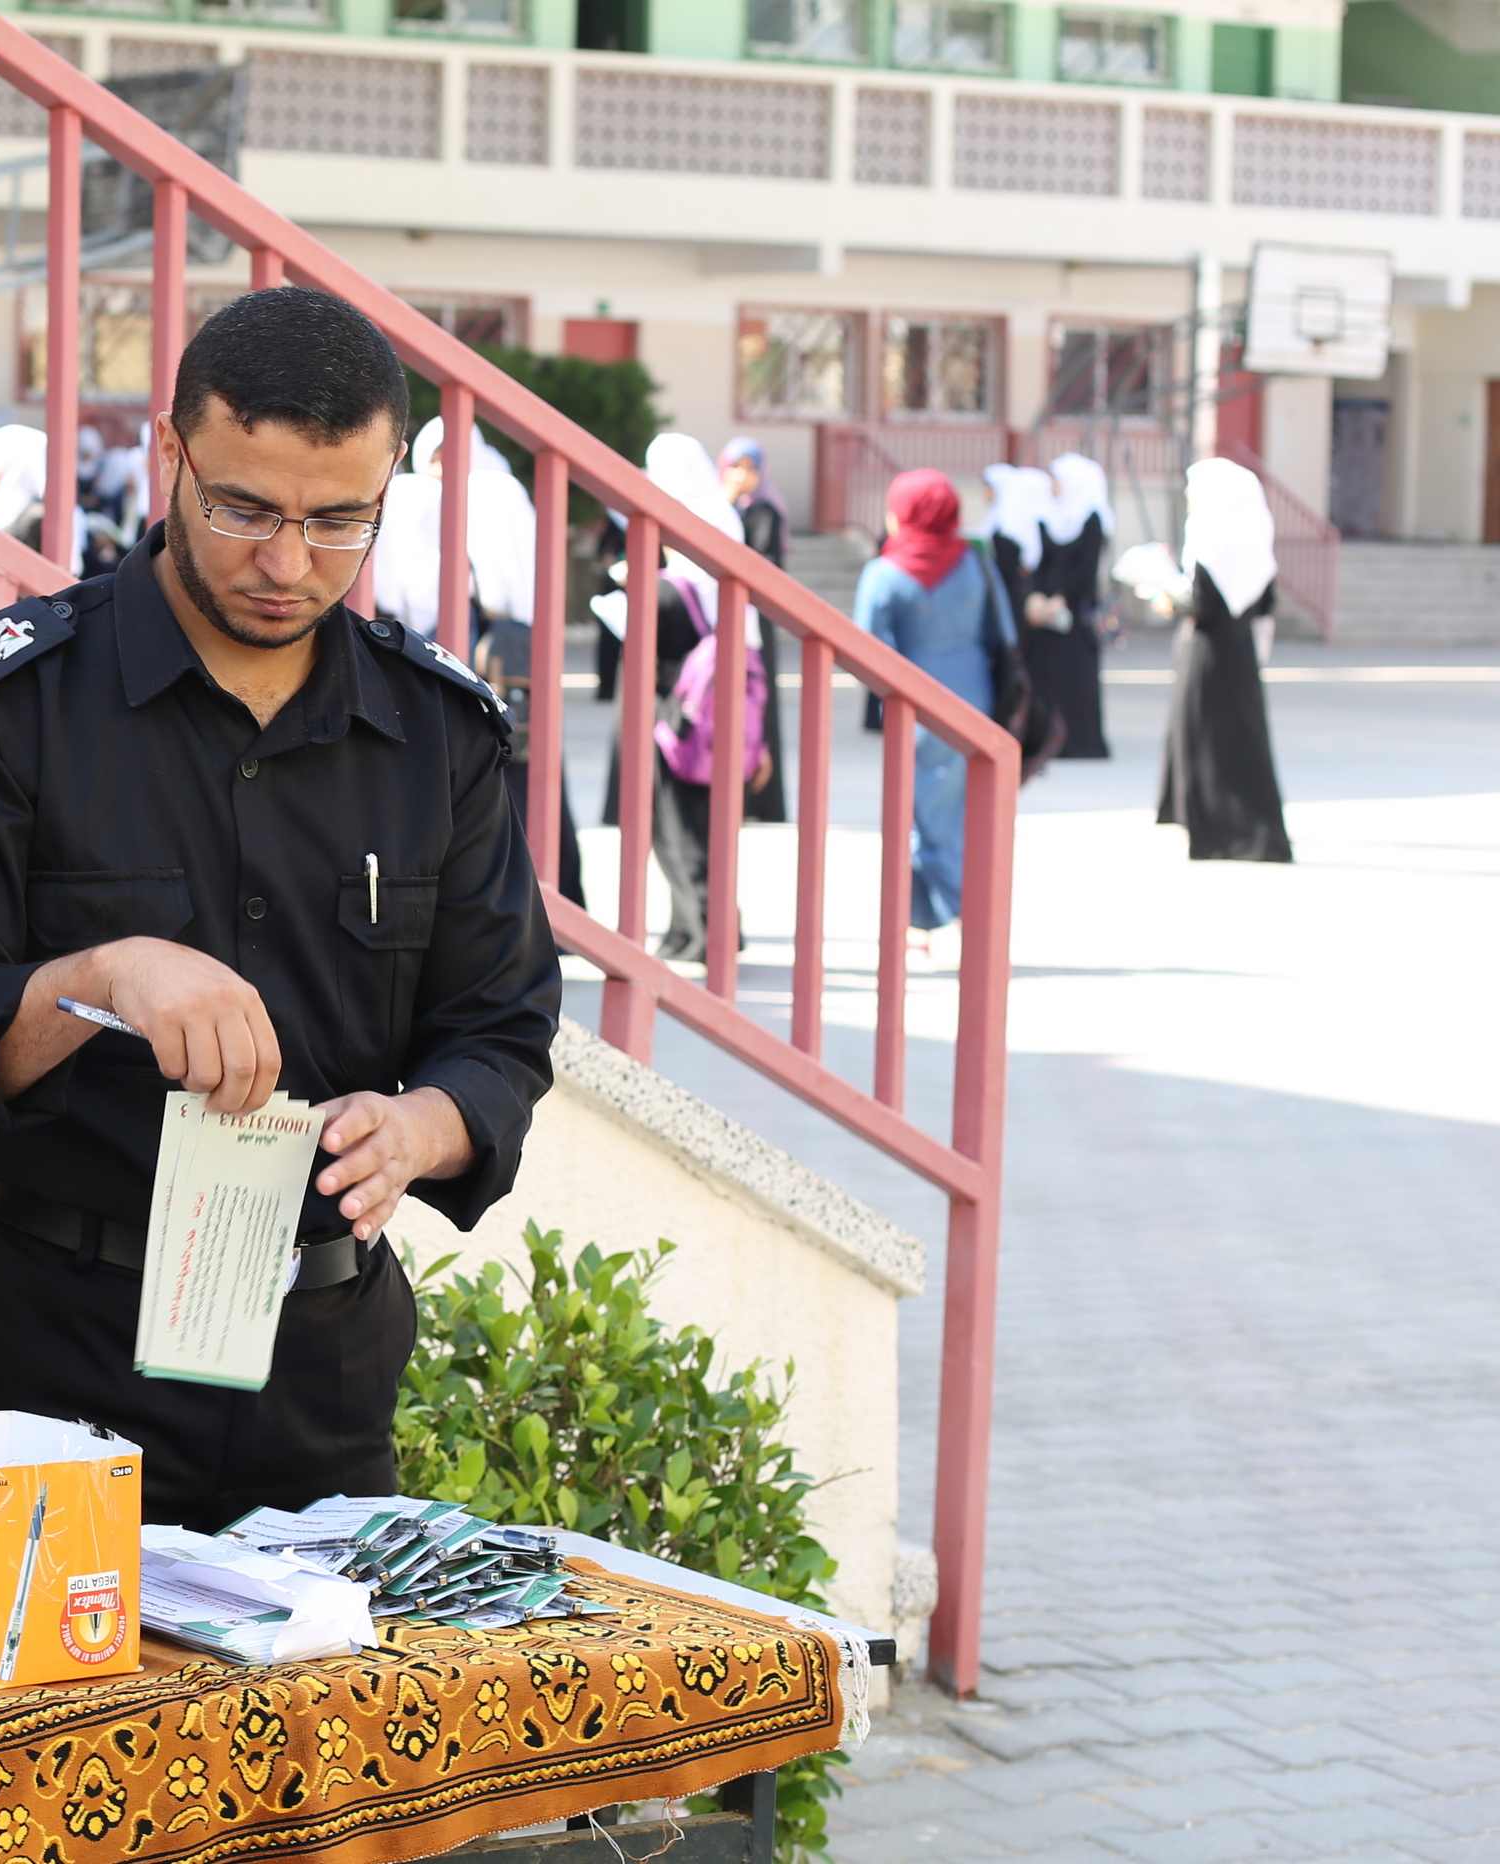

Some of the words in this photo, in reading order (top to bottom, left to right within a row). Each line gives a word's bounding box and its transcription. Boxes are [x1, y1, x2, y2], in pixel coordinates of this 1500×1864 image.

[69, 1579, 88, 1590] TOP
[91, 1574, 117, 1587] MEGA
[72, 1592, 116, 1609] Montex
[90, 1645, 116, 1663] WRITING
